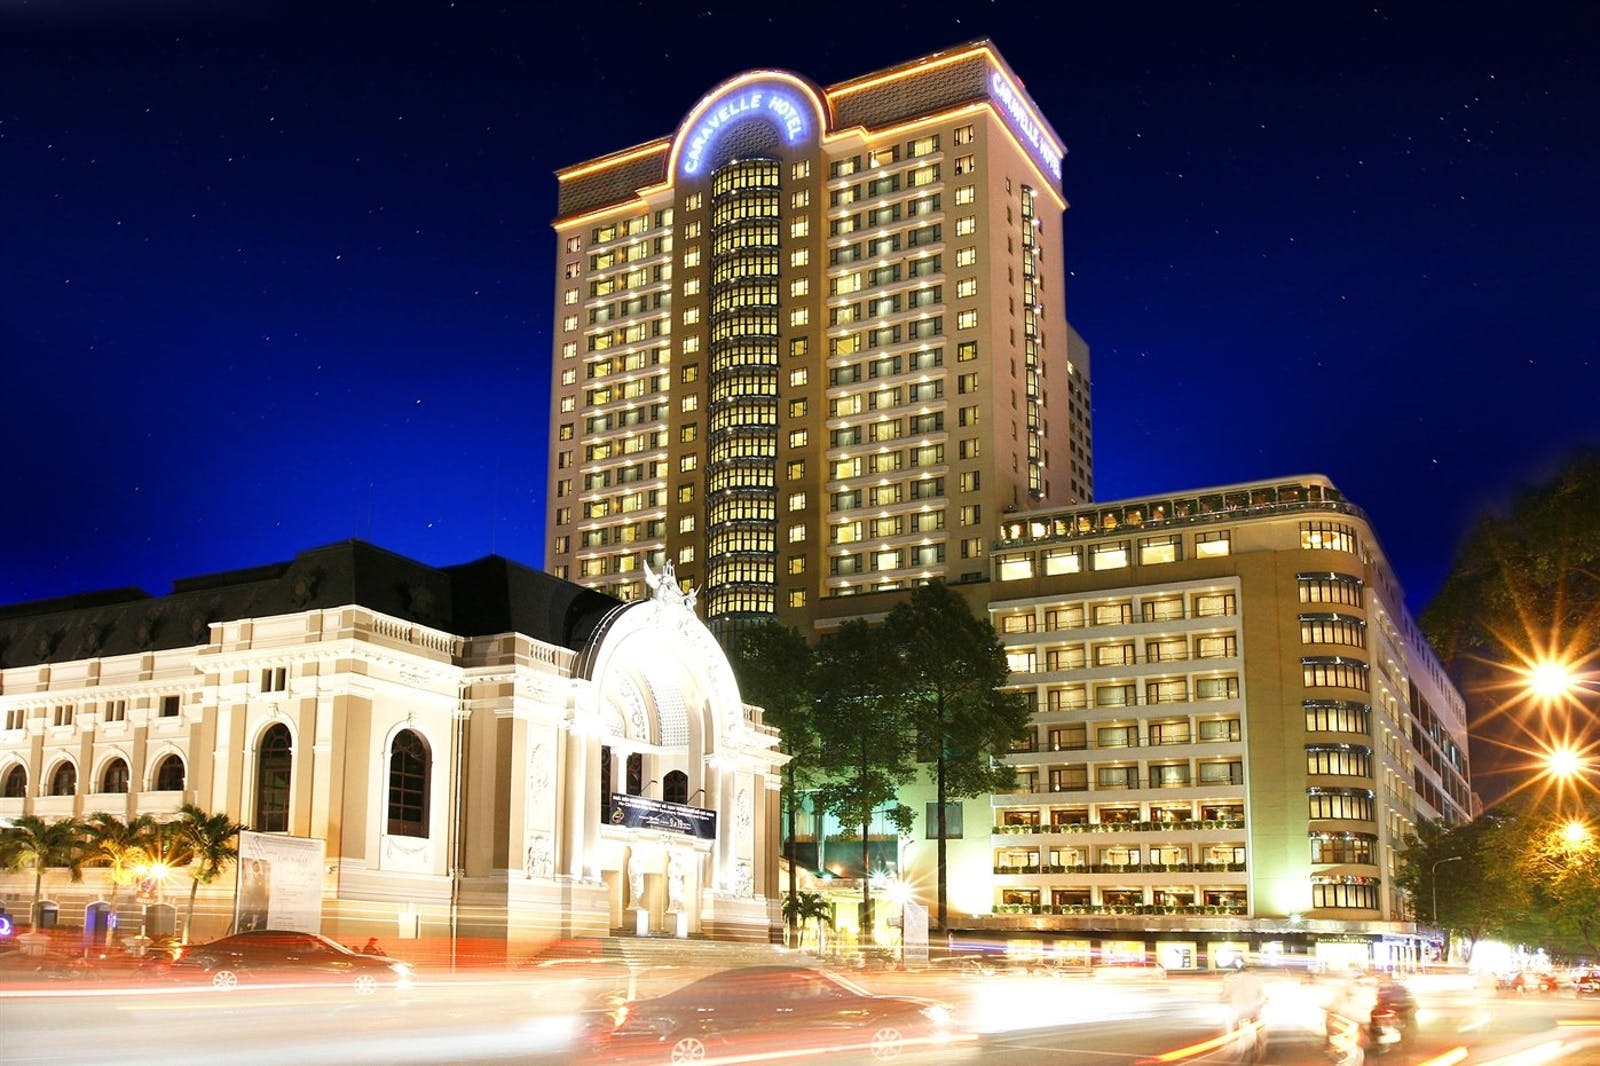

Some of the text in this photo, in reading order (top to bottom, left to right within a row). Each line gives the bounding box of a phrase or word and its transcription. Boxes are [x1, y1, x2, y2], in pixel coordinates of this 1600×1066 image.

[685, 94, 802, 173] CARAVELLE HOTEL
[993, 72, 1040, 148] CARAVELLE
